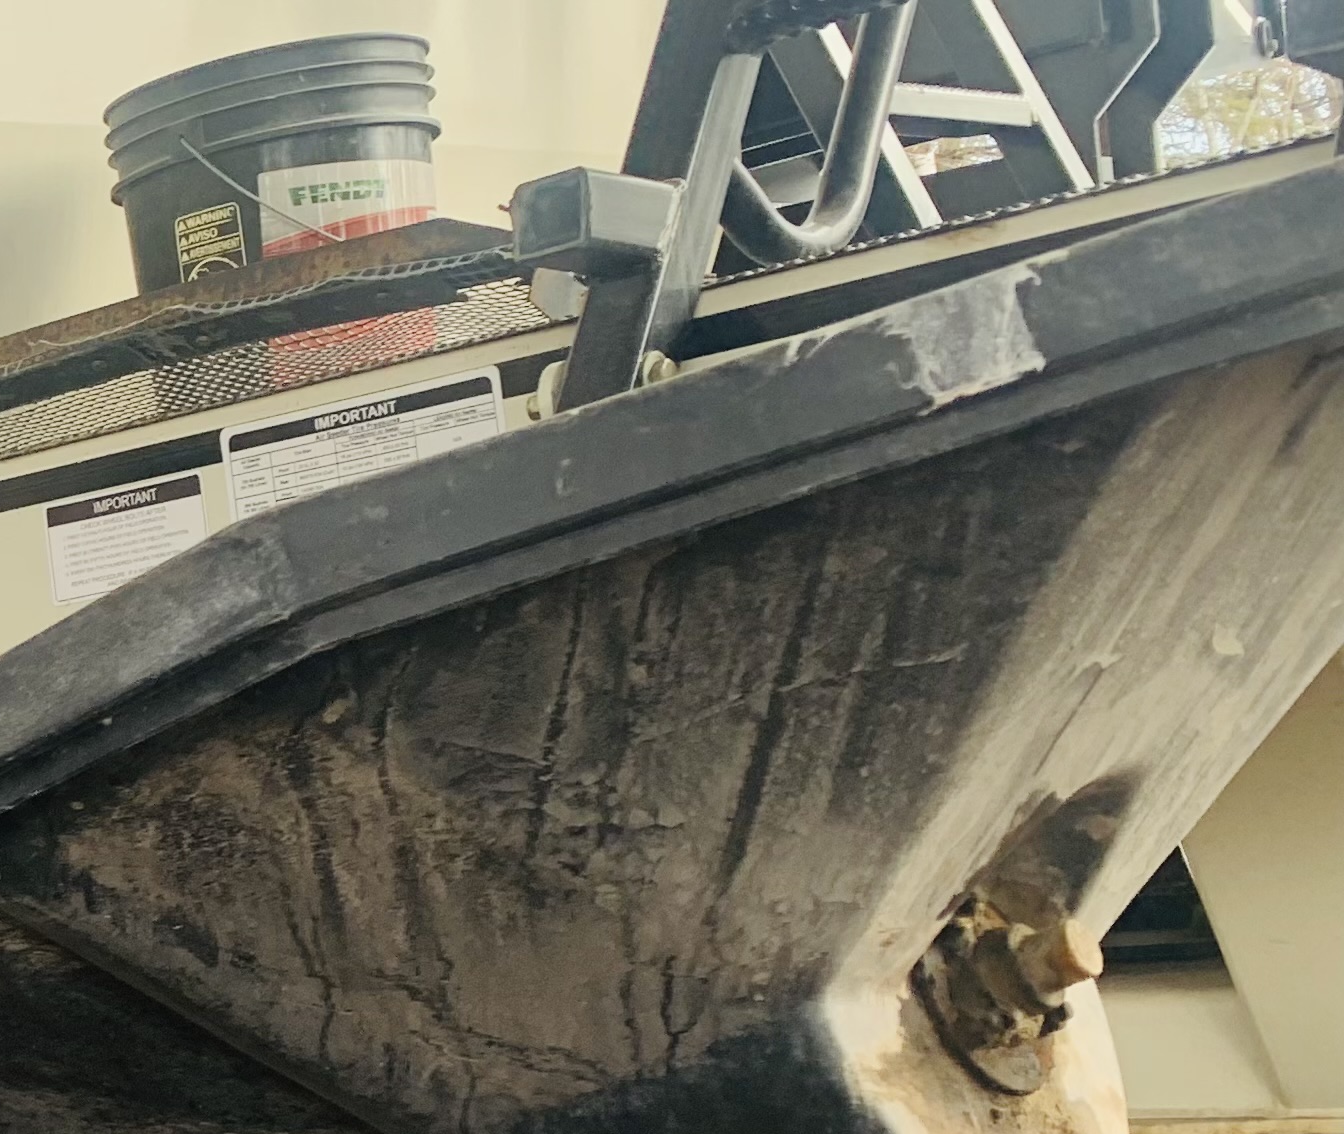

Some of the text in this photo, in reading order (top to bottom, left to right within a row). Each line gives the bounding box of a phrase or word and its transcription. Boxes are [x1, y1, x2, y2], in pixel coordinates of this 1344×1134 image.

[288, 179, 386, 207] FENDT
[189, 226, 219, 246] AVISO
[315, 401, 397, 429] IMPORTANT
[93, 488, 158, 514] IMPORTANT
